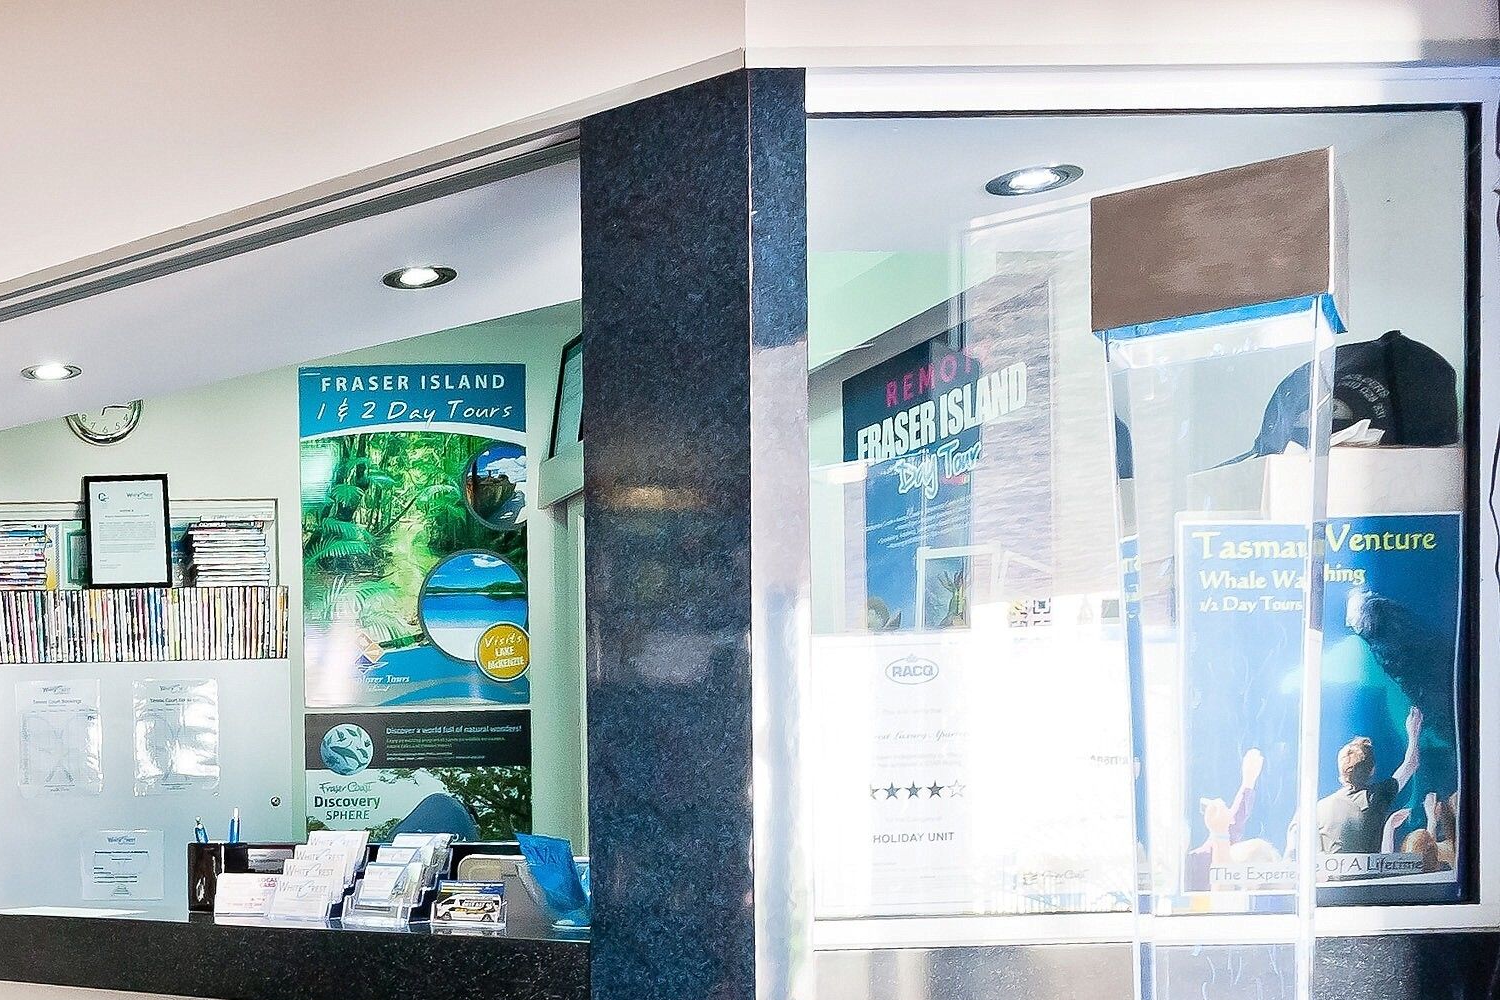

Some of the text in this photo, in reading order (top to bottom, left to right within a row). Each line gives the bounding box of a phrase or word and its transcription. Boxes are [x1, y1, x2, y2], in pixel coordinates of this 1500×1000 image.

[321, 374, 505, 392] FRASER ISLAND
[317, 398, 512, 427] 1 & 2 Day Tours
[857, 361, 1027, 462] FRASER ISLAND
[1325, 523, 1437, 552] Venture
[1199, 563, 1366, 589] Whale Wahing
[1221, 596, 1257, 613] Day
[1260, 595, 1303, 611] Tours
[484, 632, 522, 648] Visits
[892, 665, 934, 677] RACQ
[386, 727, 416, 735] Discover
[319, 781, 377, 793] Fraser Coast
[314, 796, 381, 810] Discovery
[325, 809, 370, 820] SPHERE
[873, 832, 954, 843] HOLIDAY UNIT
[1211, 867, 1241, 881] The
[1246, 862, 1320, 880] Experiee
[1325, 857, 1345, 873] Of
[1349, 858, 1363, 871] A
[1366, 856, 1423, 873] Lifetime
